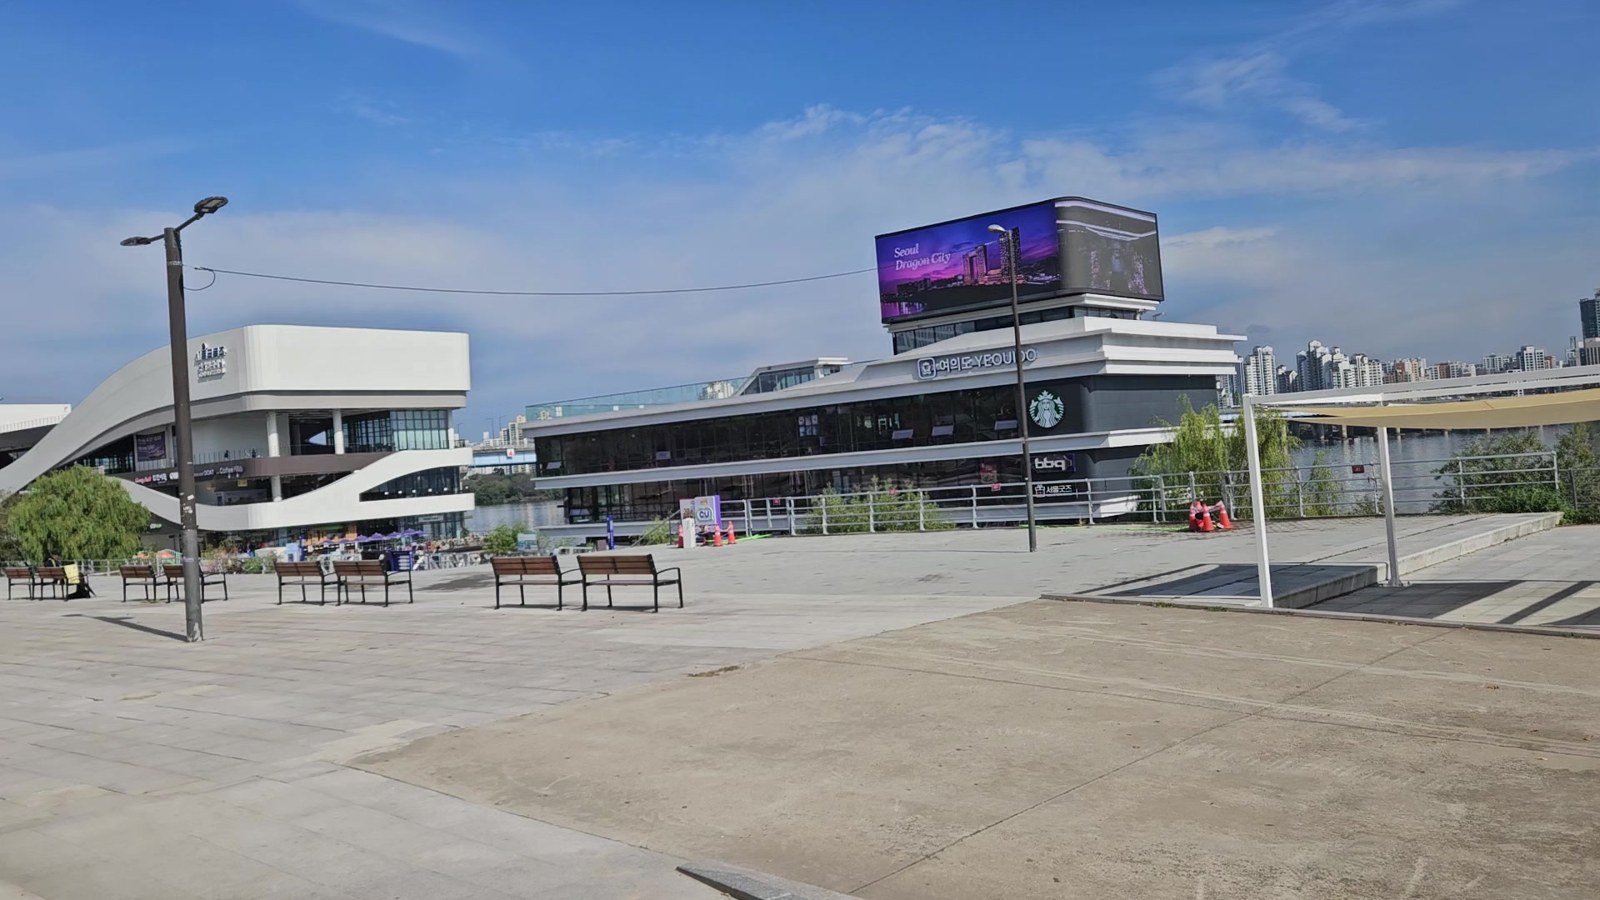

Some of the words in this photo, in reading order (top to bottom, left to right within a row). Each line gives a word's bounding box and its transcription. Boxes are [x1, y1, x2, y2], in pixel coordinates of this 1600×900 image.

[894, 243, 919, 258] Seoul
[895, 257, 929, 271] Dragon
[930, 252, 952, 264] City
[939, 356, 972, 373] 여의도
[974, 348, 1037, 368] YEOUIDO
[1034, 457, 1066, 471] bbq
[1046, 484, 1072, 493] 서울굿즈
